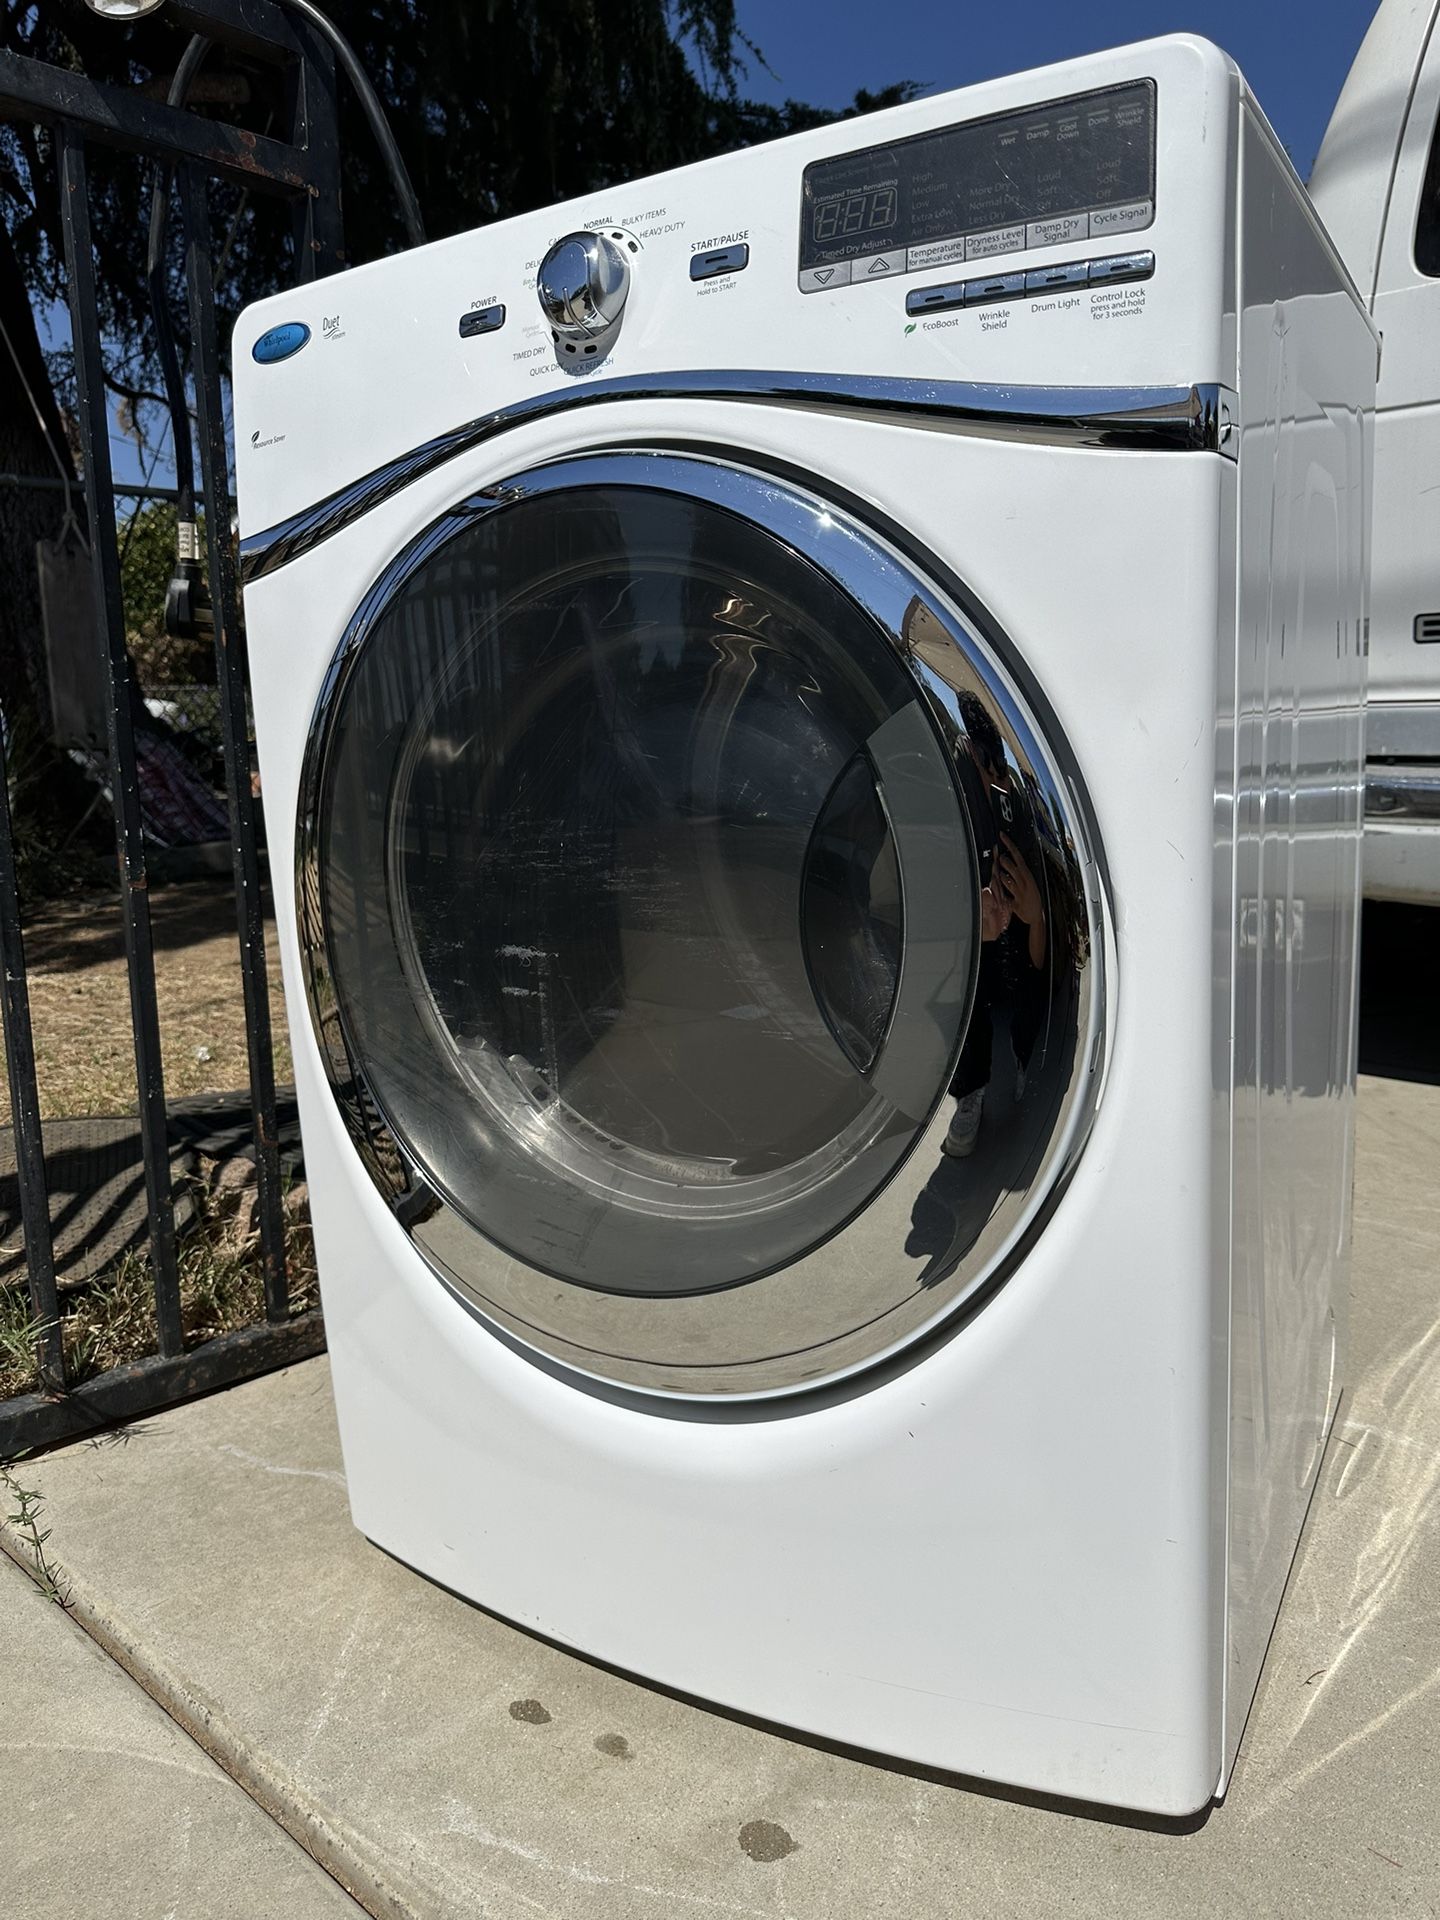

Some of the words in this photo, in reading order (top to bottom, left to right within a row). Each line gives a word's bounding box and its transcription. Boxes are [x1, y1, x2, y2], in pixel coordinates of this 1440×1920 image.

[1026, 129, 1050, 141] Damp
[1059, 122, 1078, 133] Cool
[1000, 136, 1016, 147] Wet
[1056, 130, 1080, 141] Down
[1096, 157, 1121, 171] Loud
[1096, 174, 1120, 186] Soft
[1095, 187, 1113, 200] Off
[912, 201, 930, 211] Low
[583, 216, 614, 230] NORMAL
[621, 212, 645, 227] BULKY
[644, 207, 667, 219] ITEMS
[1093, 213, 1119, 225] Cycle
[1119, 206, 1148, 221] Signal
[639, 227, 663, 239] HEAVY
[662, 220, 686, 233] DUTY
[1035, 222, 1062, 234] Damp
[1062, 218, 1080, 231] Dry
[690, 229, 750, 253] START/PAUSE
[967, 235, 1000, 248] Dryness
[1001, 228, 1025, 240] Level
[1043, 228, 1071, 243] Signal
[846, 244, 860, 255] Dry
[861, 238, 889, 251] Adjust
[910, 241, 962, 258] Temperature
[697, 287, 711, 297] Hold
[719, 281, 737, 292] START
[703, 279, 719, 287] Press
[719, 276, 731, 284] and
[470, 295, 497, 310] POWER
[1089, 294, 1122, 305] Control
[1123, 288, 1146, 299] Lock
[1030, 301, 1056, 314] Drum
[1056, 297, 1081, 311] Light
[1089, 305, 1110, 315] press
[1110, 302, 1125, 311] and
[1125, 297, 1145, 307] hold
[979, 309, 1011, 322] Wrinkle
[1091, 311, 1104, 321] for
[1104, 310, 1110, 319] 3
[1110, 306, 1144, 318] seconds
[322, 315, 340, 331] Duet
[922, 317, 959, 332] EcoBoost
[981, 320, 1008, 332] Shield
[512, 349, 533, 361] TIMED
[532, 345, 547, 357] DRY
[529, 365, 550, 377] QUICK
